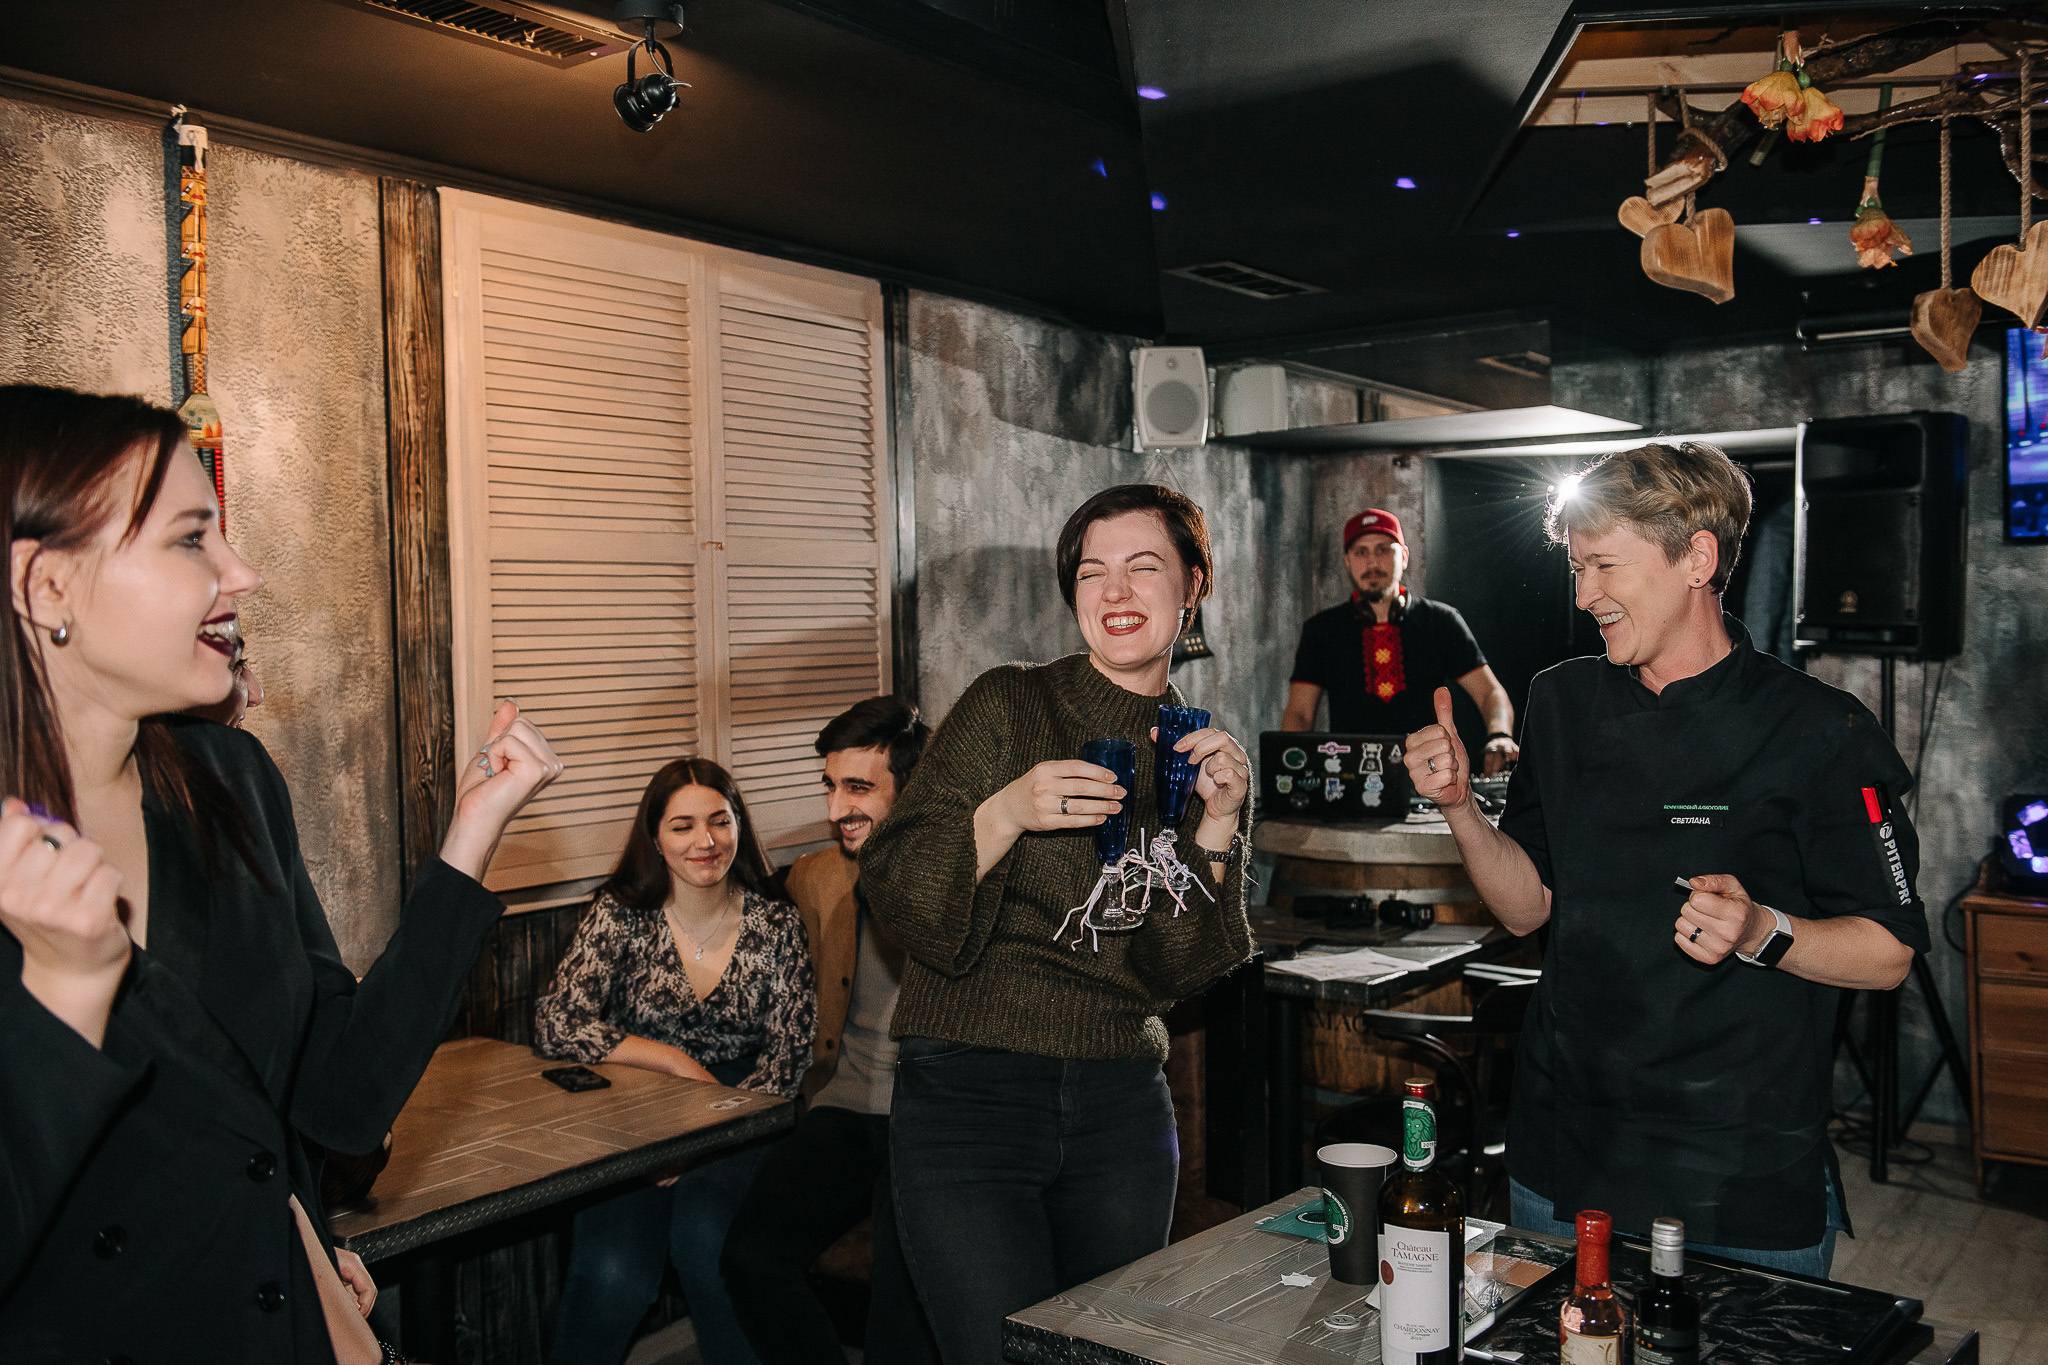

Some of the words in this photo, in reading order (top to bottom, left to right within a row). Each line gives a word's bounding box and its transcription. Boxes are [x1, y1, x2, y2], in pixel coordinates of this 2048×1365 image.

[1671, 817, 1711, 825] СВЕТЛАНА
[1396, 1241, 1432, 1253] Château
[1391, 1247, 1439, 1262] TAMAGNE
[1393, 1323, 1441, 1334] CHARDONNAY
